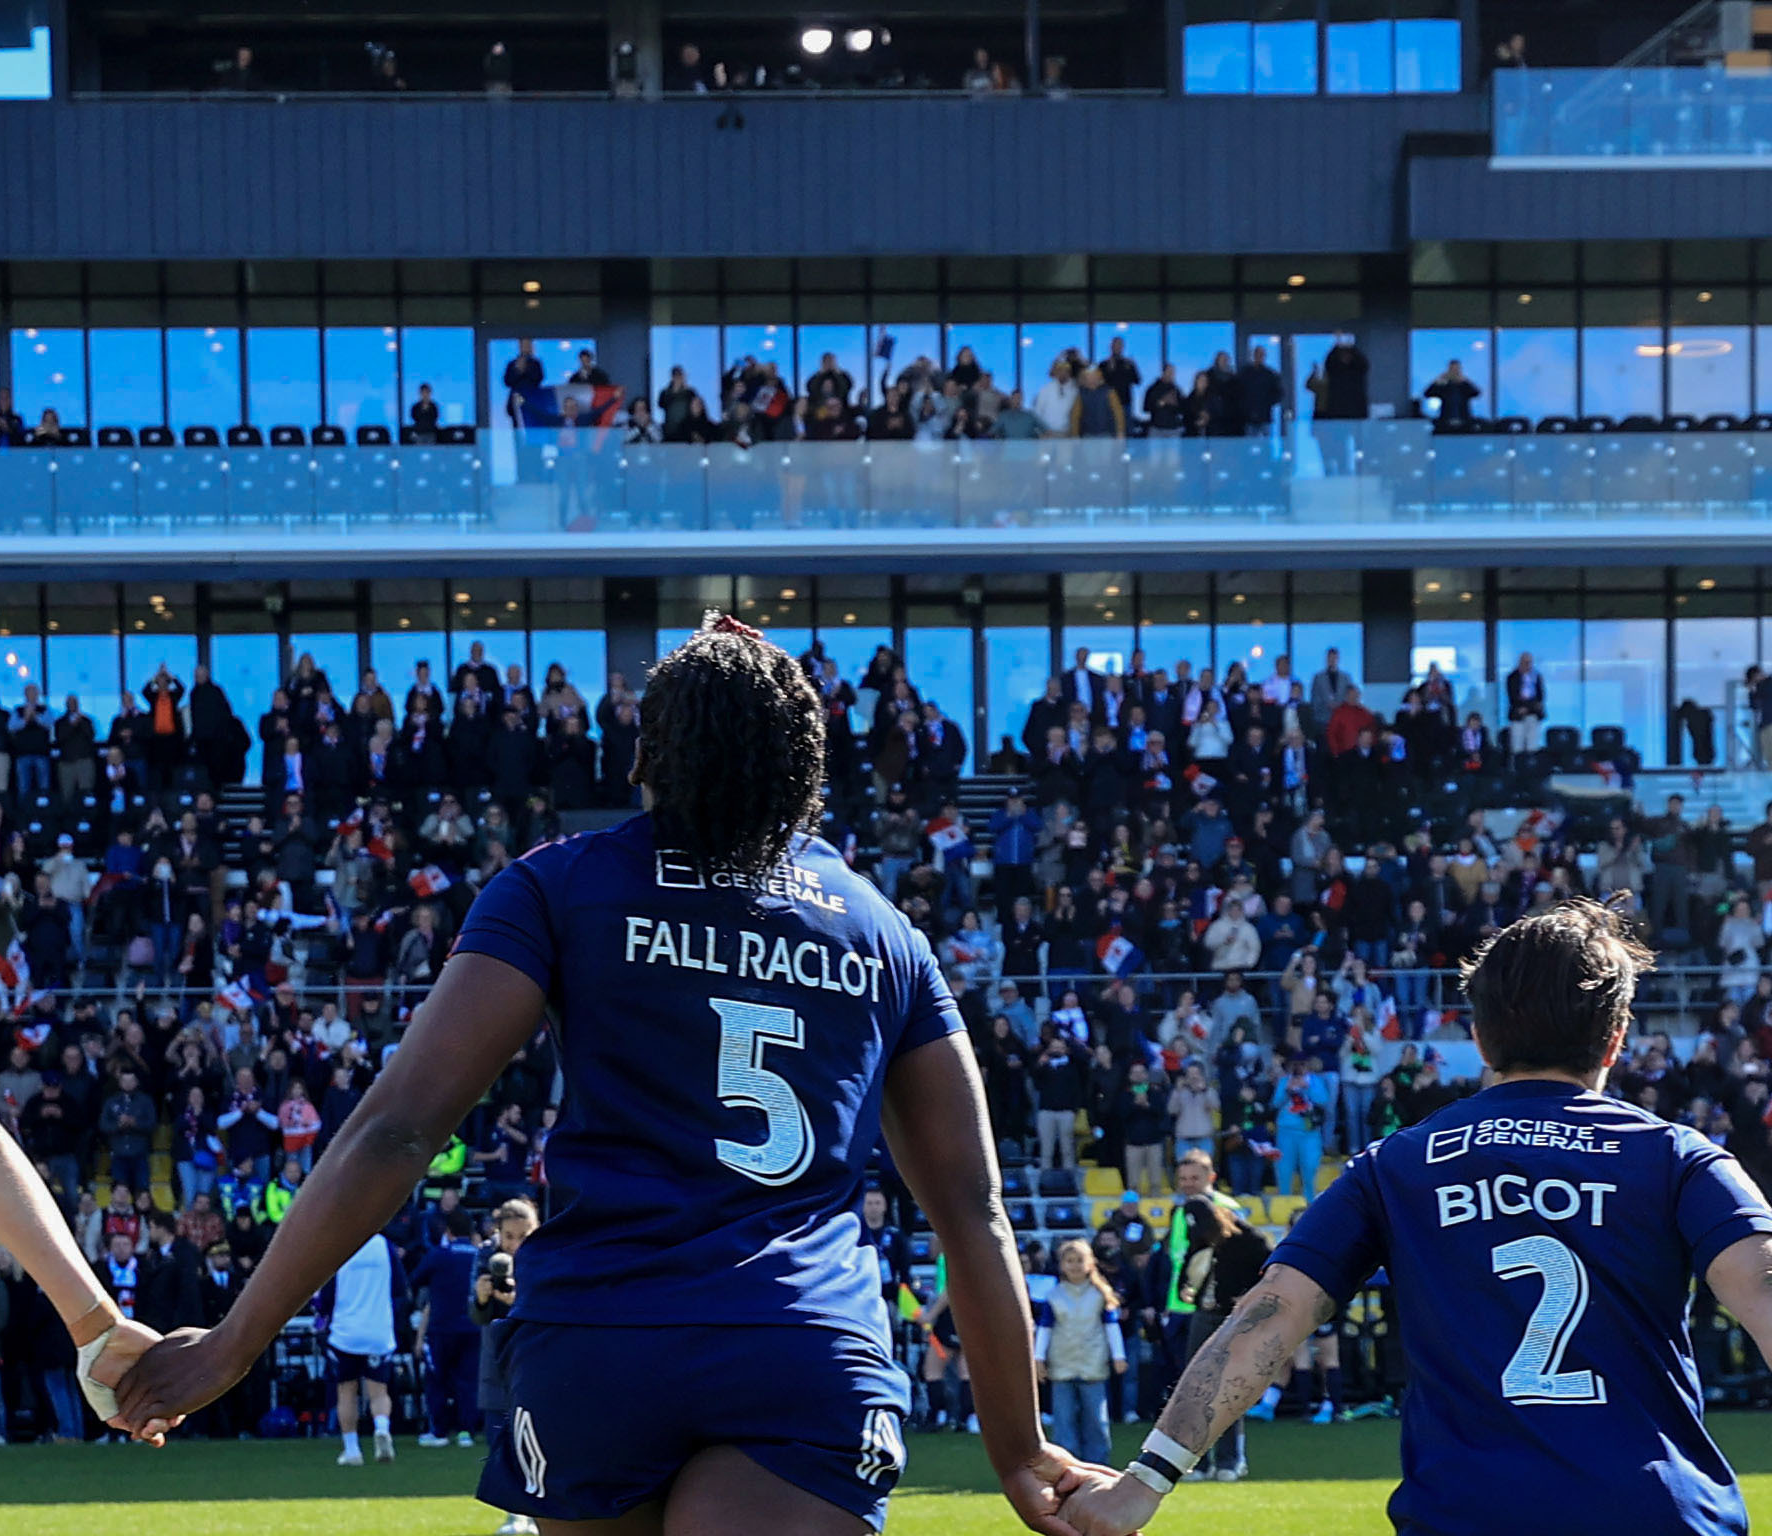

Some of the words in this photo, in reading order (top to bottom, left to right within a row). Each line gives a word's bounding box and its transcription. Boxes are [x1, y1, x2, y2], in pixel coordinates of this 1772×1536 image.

[625, 916, 729, 974] FALL
[737, 930, 884, 1002] RACLOT
[708, 997, 816, 1187] 5
[1474, 1131, 1622, 1153] GENERALE
[1475, 1118, 1596, 1140] SOCIETE
[1435, 1174, 1618, 1228] BIGOT
[1491, 1235, 1608, 1406] 2
